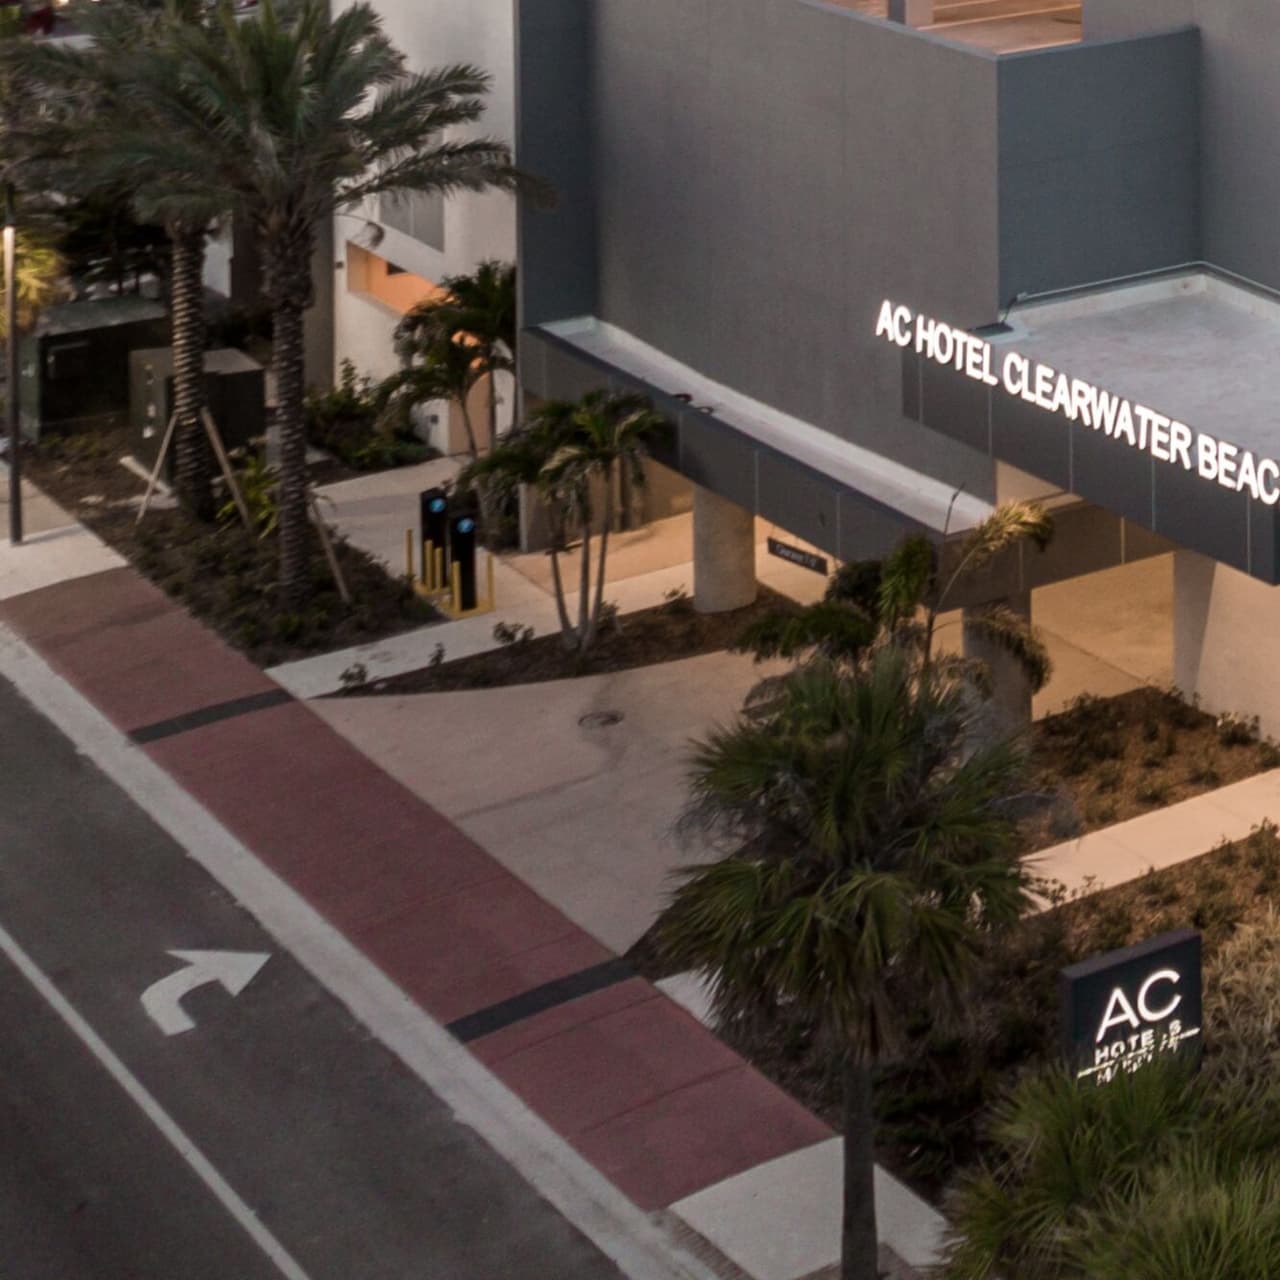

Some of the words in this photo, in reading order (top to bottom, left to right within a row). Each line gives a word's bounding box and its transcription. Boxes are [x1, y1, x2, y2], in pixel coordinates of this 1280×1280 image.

[876, 300, 912, 346] AC
[916, 314, 999, 385] HOTEL
[1003, 351, 1192, 470] CLEARWATER
[1095, 1019, 1182, 1066] HOTES
[1096, 969, 1182, 1043] AC
